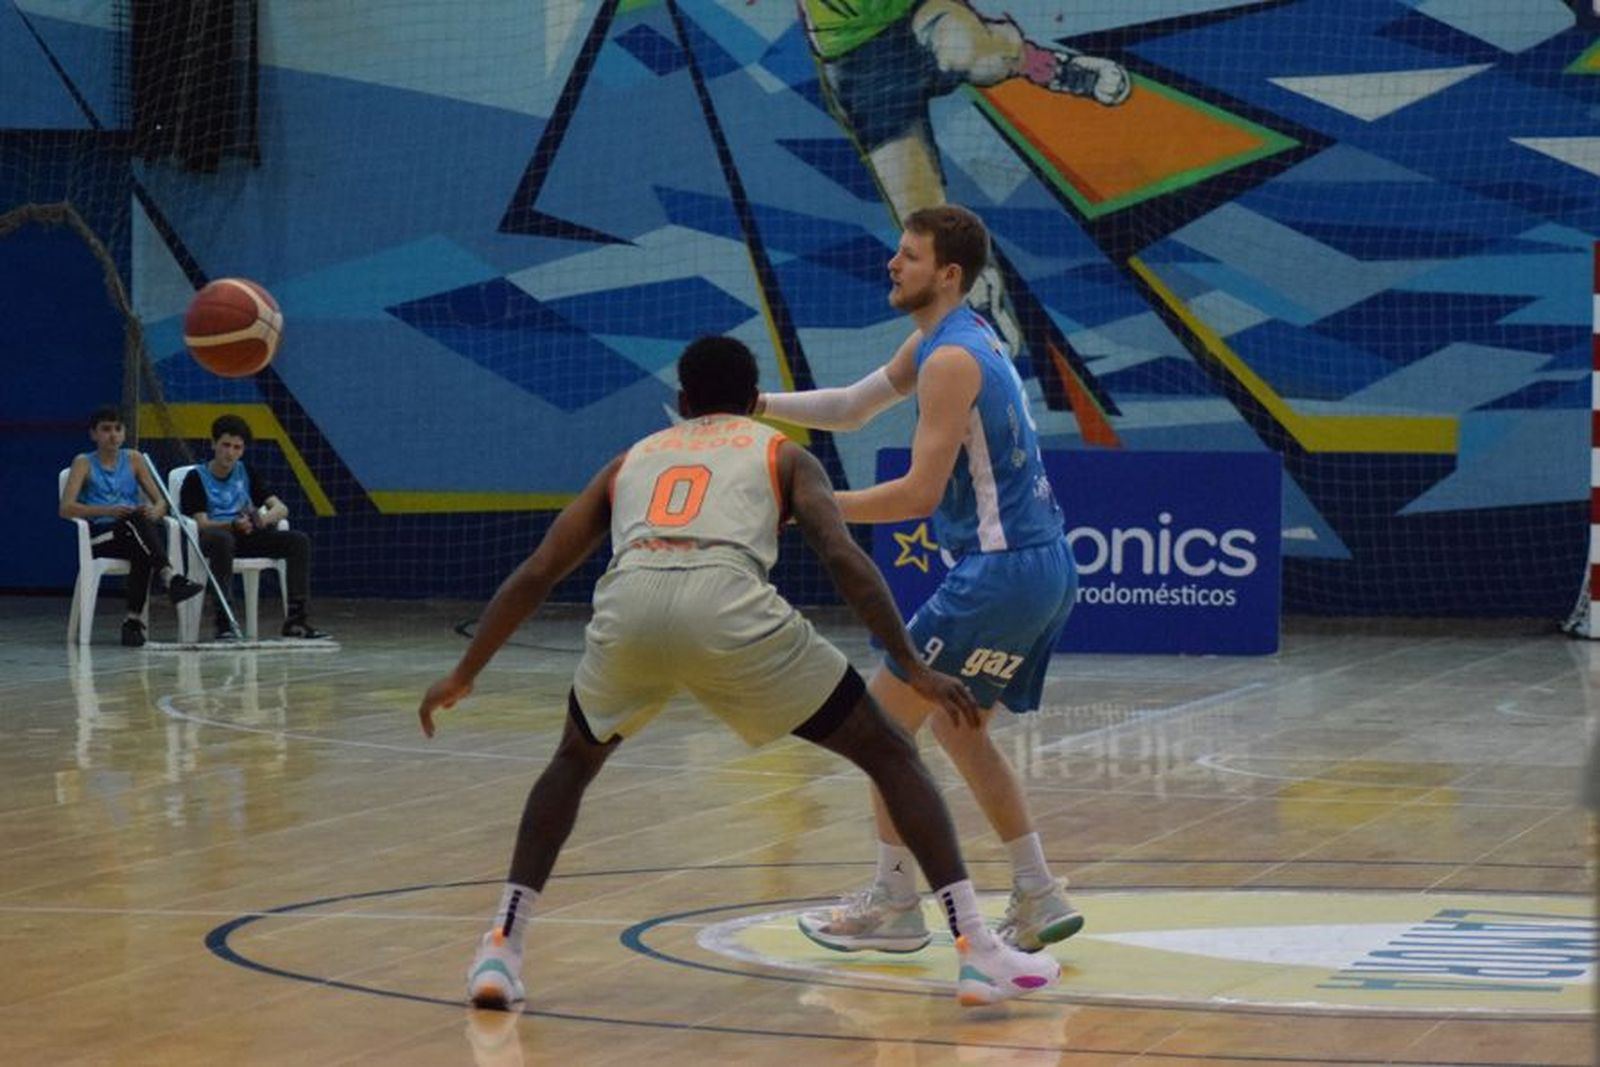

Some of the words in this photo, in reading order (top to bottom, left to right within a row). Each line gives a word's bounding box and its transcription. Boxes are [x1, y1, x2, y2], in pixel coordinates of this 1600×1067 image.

[646, 464, 713, 528] 0
[940, 512, 1257, 577] onics
[1076, 581, 1237, 606] rodomésticos
[920, 636, 944, 667] 9
[961, 647, 1024, 680] gaz
